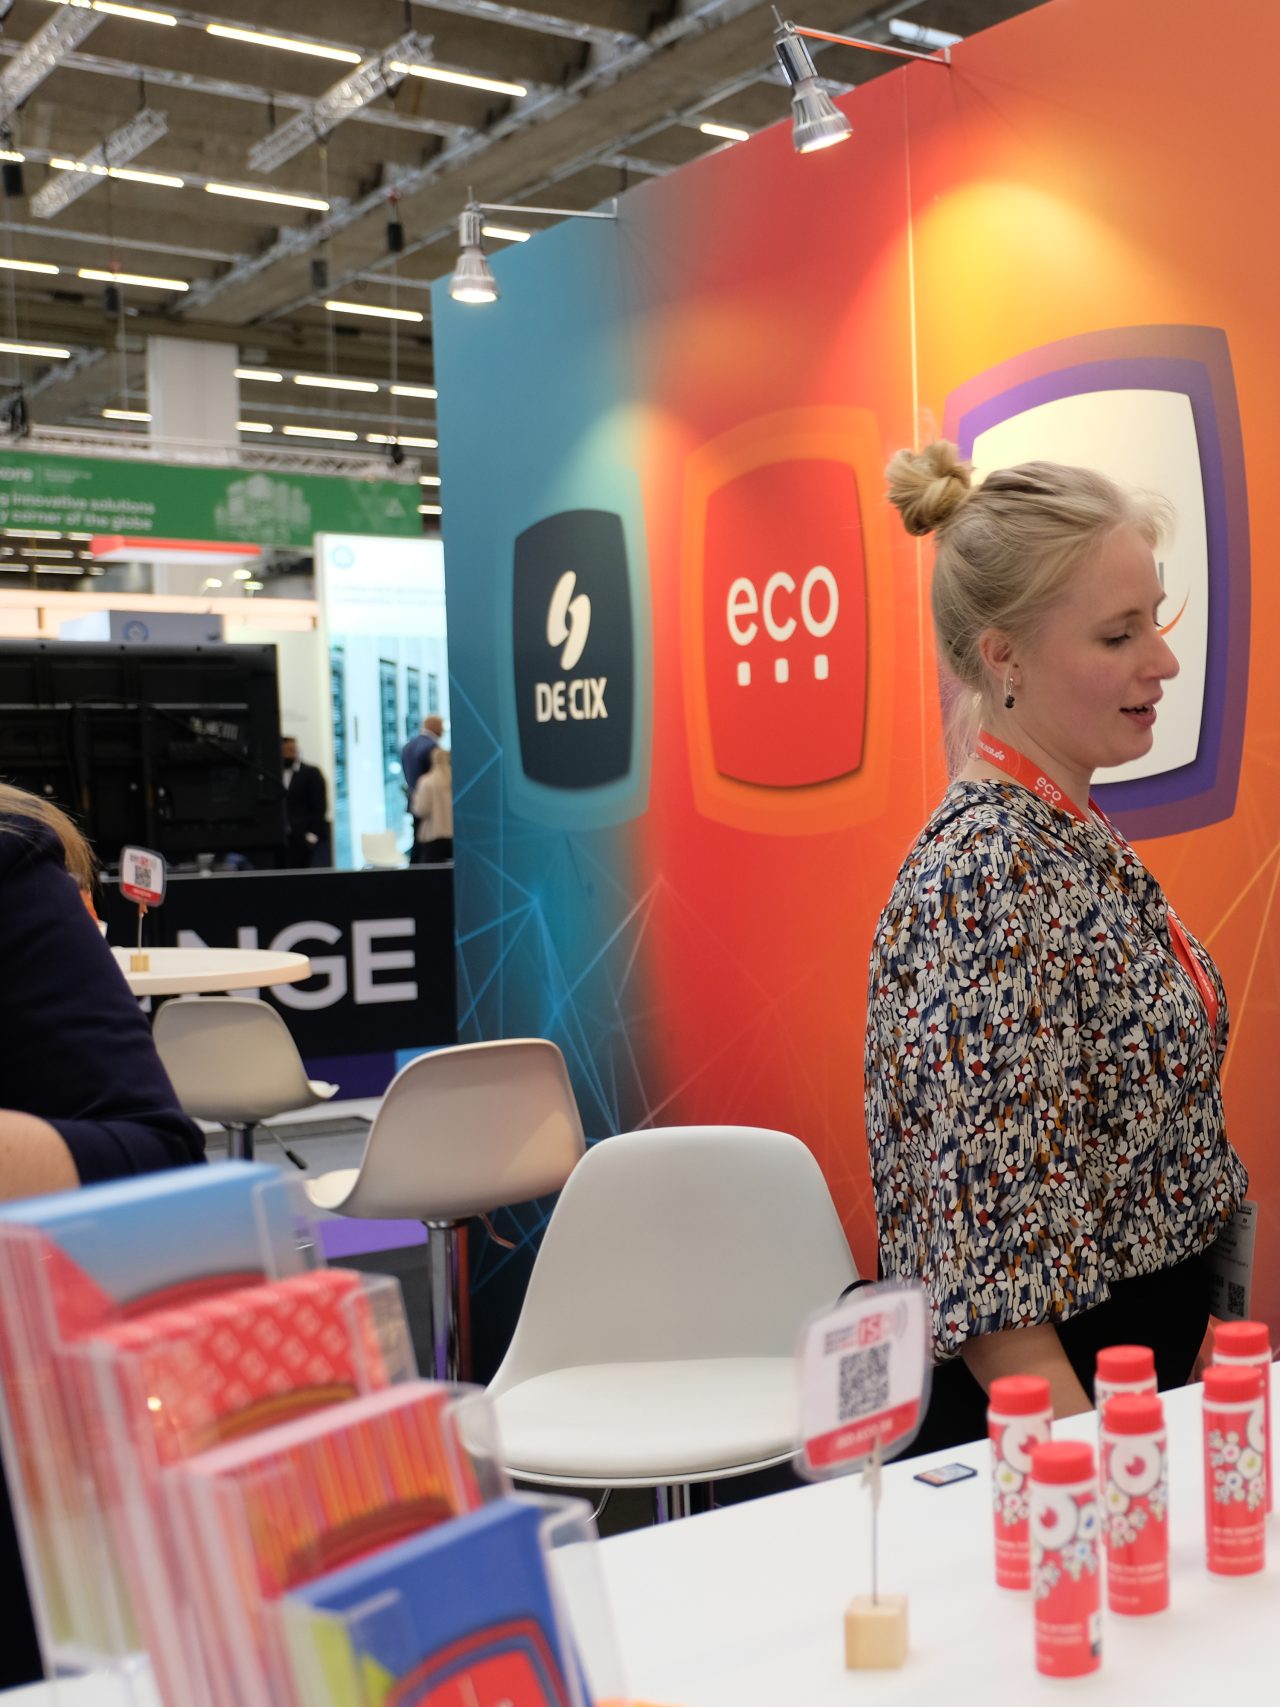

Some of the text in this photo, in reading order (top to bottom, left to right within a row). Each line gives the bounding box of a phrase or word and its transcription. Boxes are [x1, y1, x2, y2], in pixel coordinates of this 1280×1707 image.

[91, 498, 156, 515] solutions
[85, 512, 109, 527] the
[112, 515, 152, 531] globe
[726, 565, 839, 646] eco
[1036, 777, 1062, 801] eco
